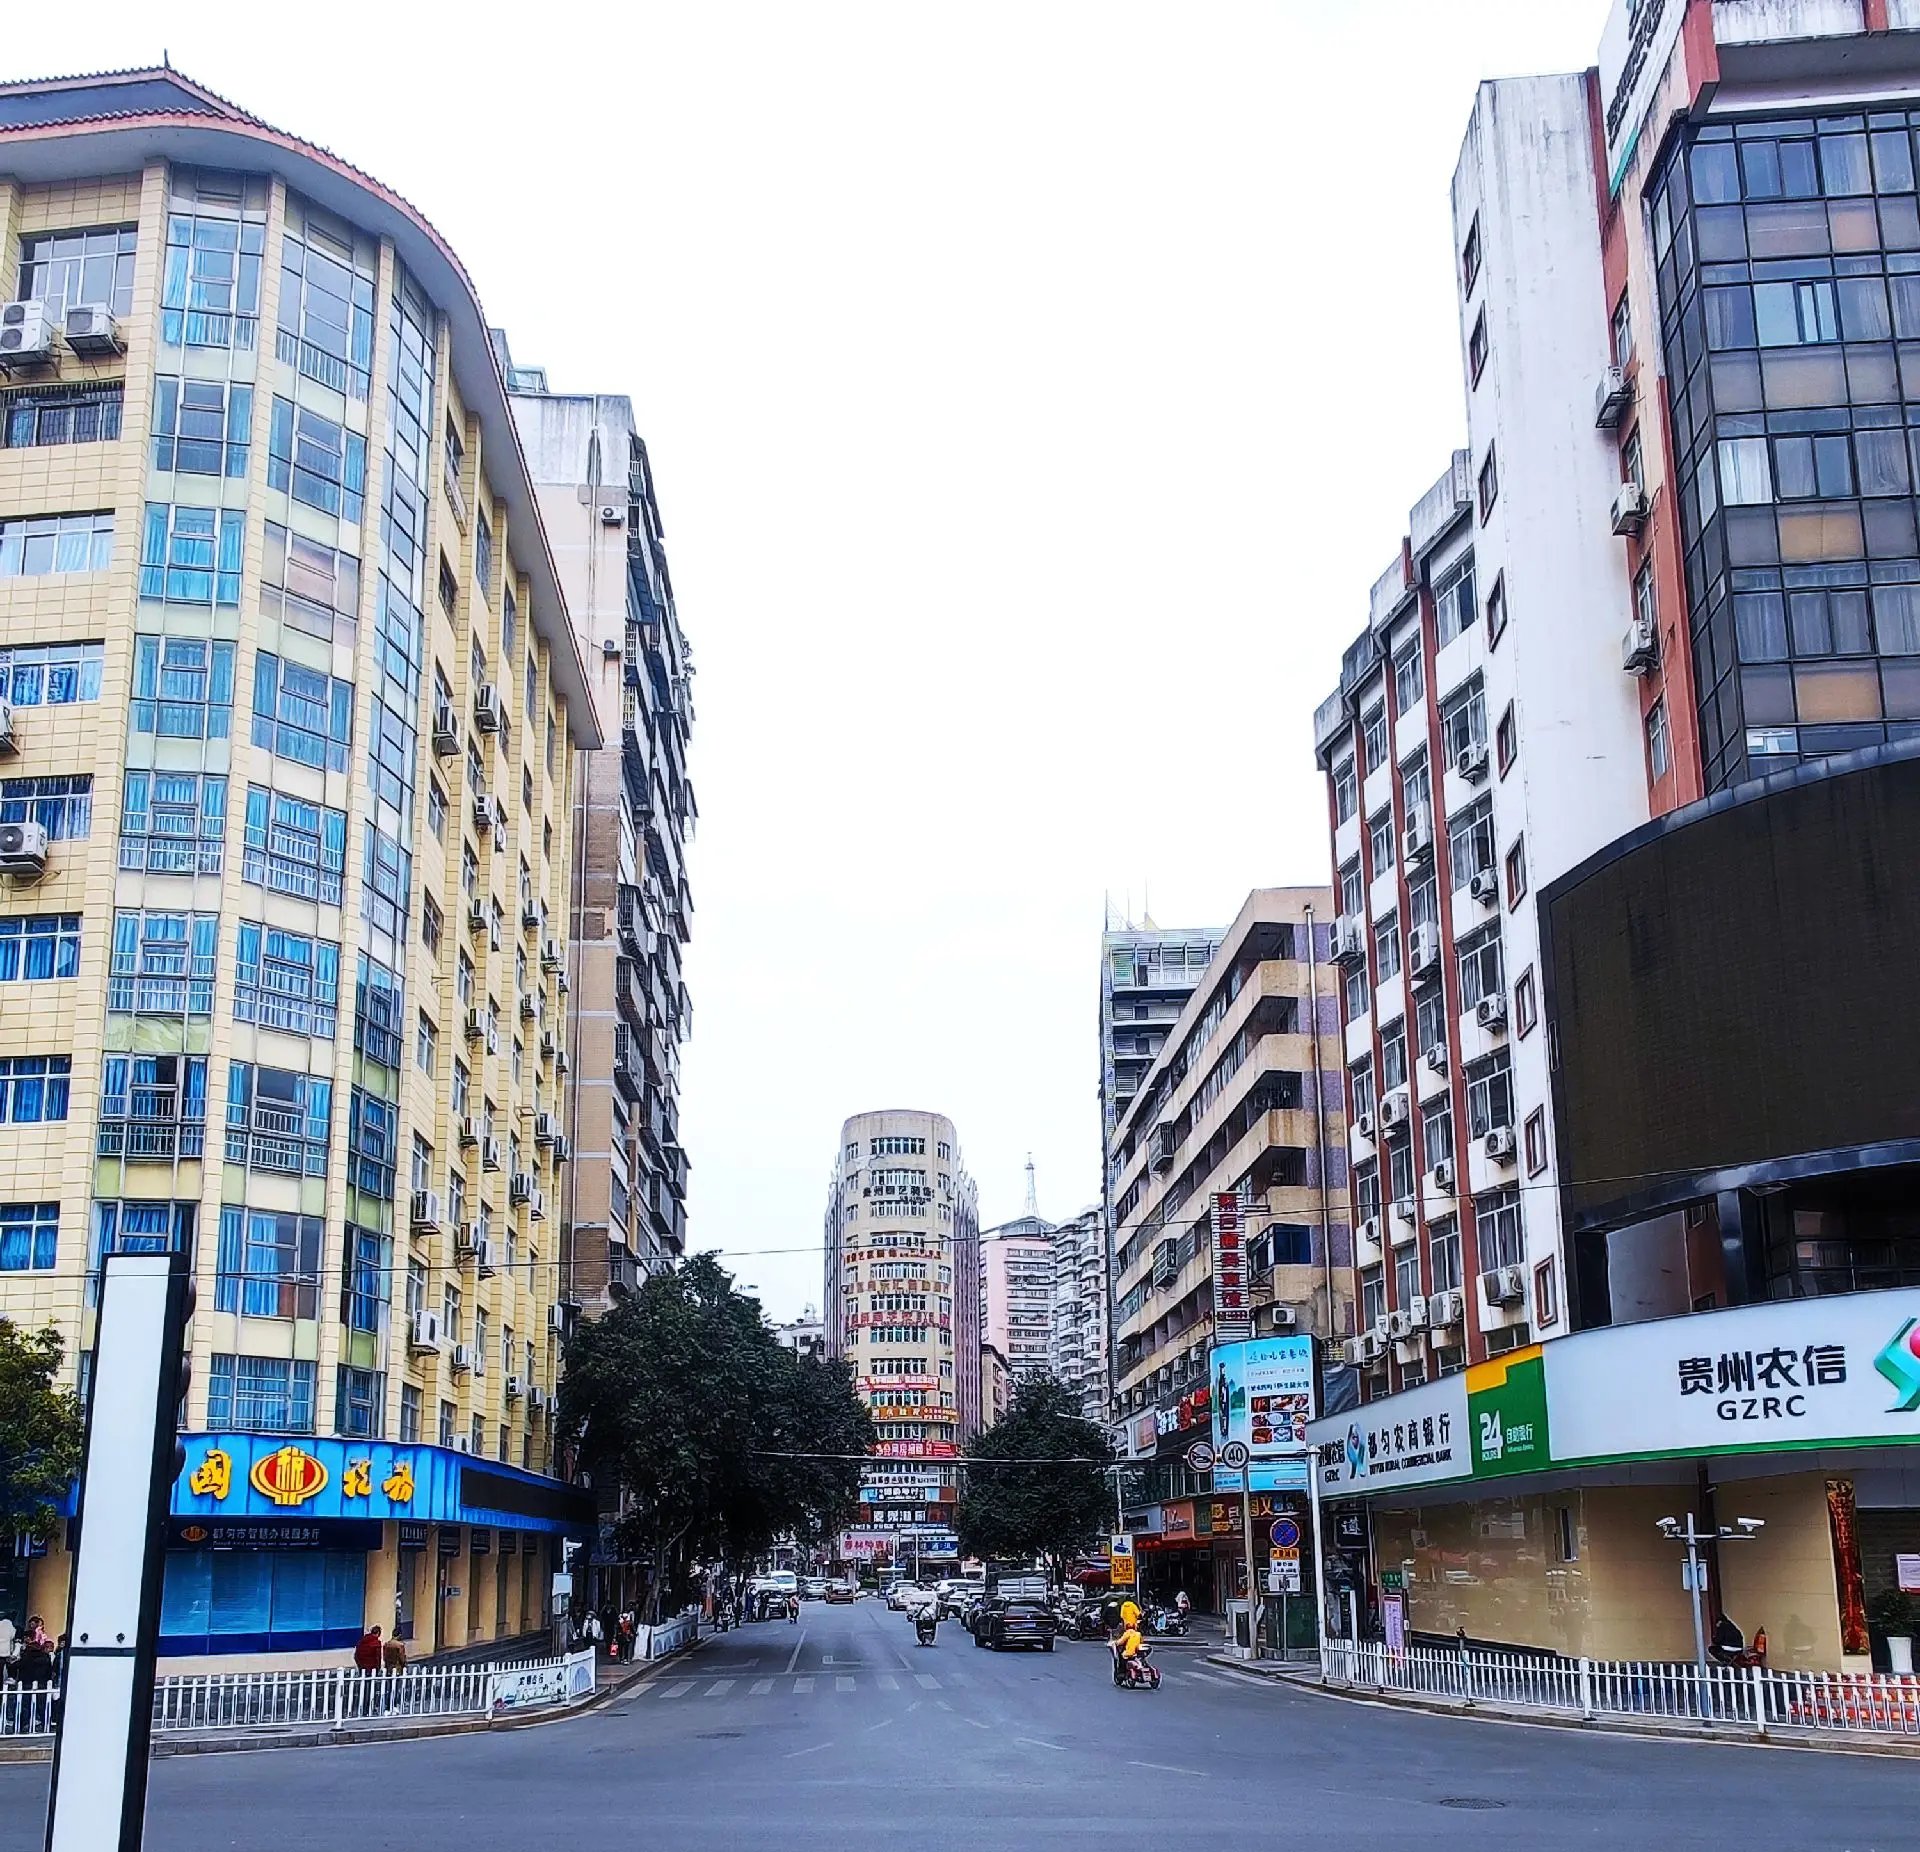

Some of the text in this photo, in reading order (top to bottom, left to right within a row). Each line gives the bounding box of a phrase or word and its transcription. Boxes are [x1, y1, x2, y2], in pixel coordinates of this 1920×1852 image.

[1679, 1345, 1847, 1396] 贵州农信
[1717, 1395, 1806, 1420] GZRC
[1228, 1446, 1243, 1462] 40
[1368, 1413, 1451, 1459] 都匀农商银行
[1480, 1410, 1503, 1459] 24
